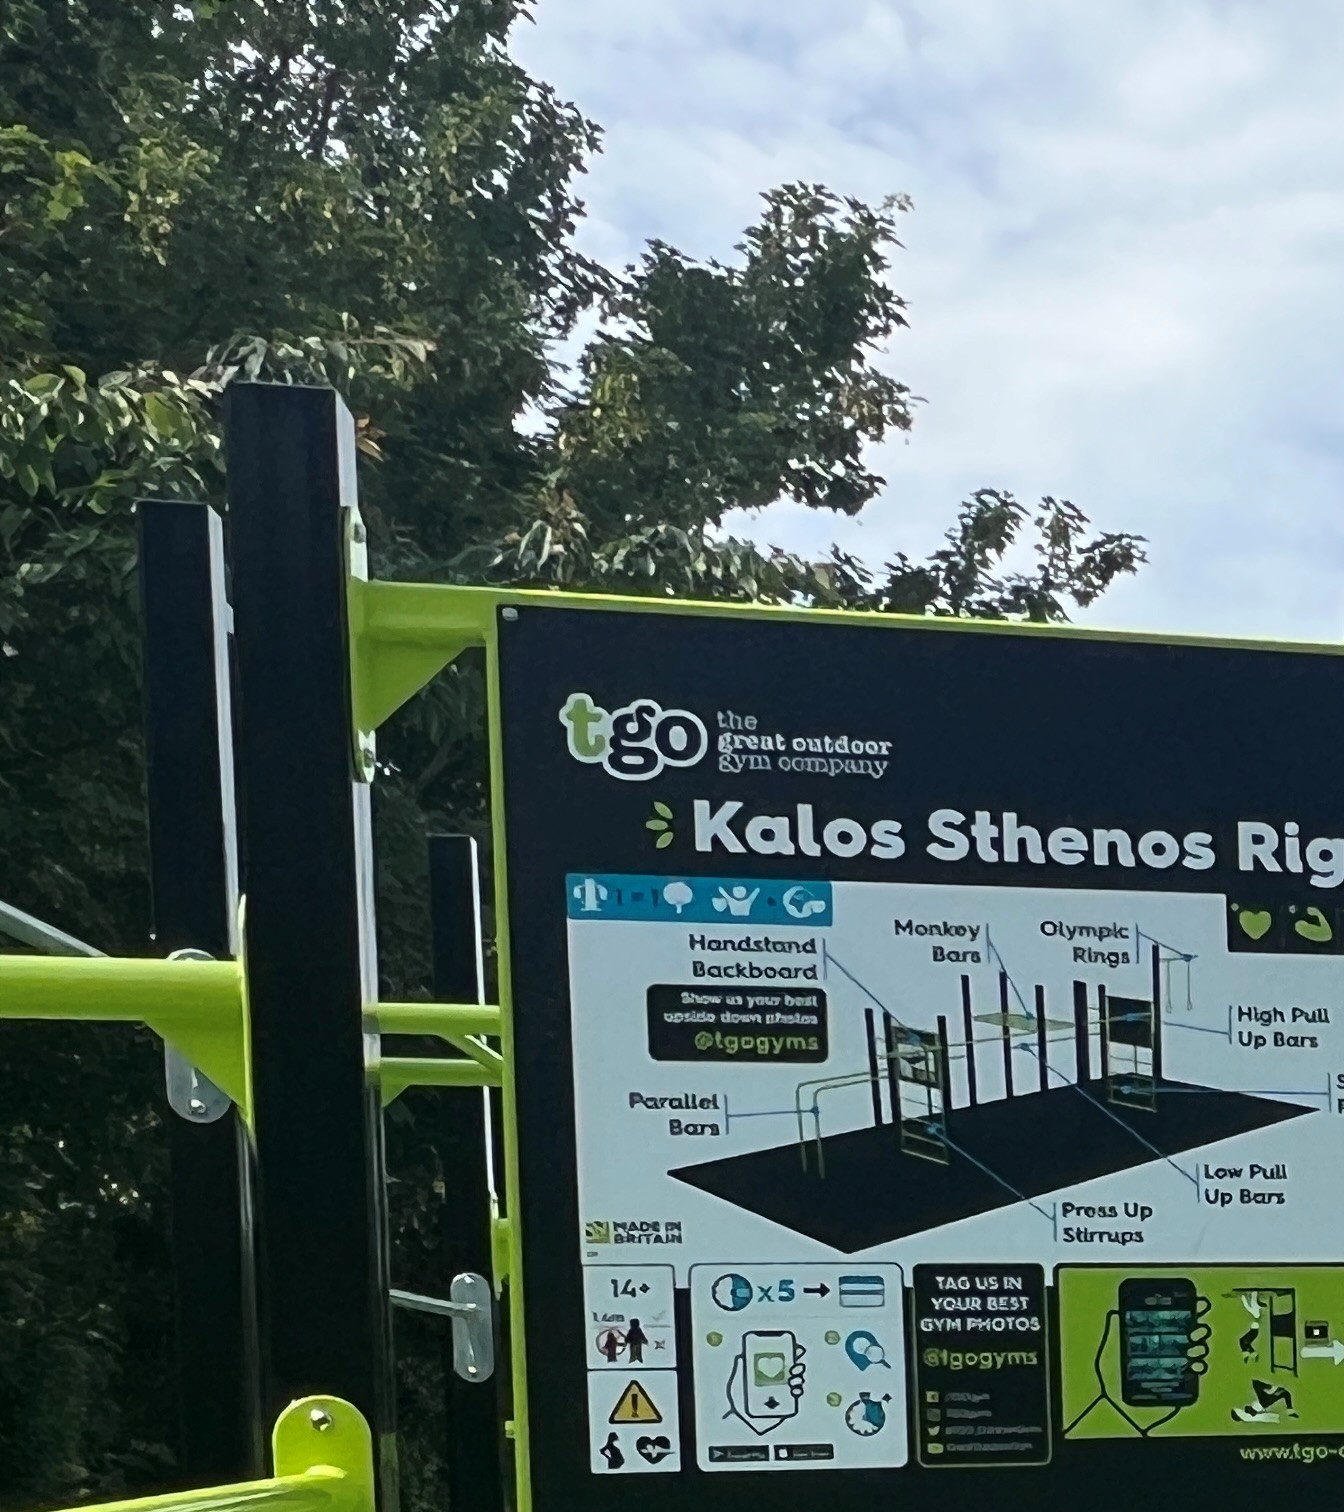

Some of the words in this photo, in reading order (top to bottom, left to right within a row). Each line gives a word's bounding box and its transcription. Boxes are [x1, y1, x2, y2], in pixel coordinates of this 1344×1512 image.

[717, 711, 758, 730] the
[559, 693, 708, 781] tgo
[717, 733, 785, 754] great
[792, 736, 893, 755] outdoor
[718, 753, 772, 773] gym
[779, 754, 889, 779] company
[693, 799, 905, 859] Kalos
[926, 808, 1216, 870] Sthenos
[894, 919, 981, 941] Monkey
[1040, 920, 1130, 941] Olympic
[689, 934, 818, 954] Handstand
[932, 946, 982, 963] Bars
[1073, 947, 1131, 968] Rings
[692, 961, 818, 980] Backboard
[1238, 1005, 1285, 1026] High
[1291, 1007, 1331, 1024] Pull
[694, 1031, 819, 1054] @tgogyms
[1238, 1031, 1267, 1050] Up
[1273, 1032, 1319, 1048] Bars
[629, 1091, 720, 1110] Parallel
[669, 1119, 720, 1136] Bars
[1204, 1164, 1243, 1180] Low
[1249, 1163, 1288, 1180] Pull
[1204, 1188, 1233, 1207] Up
[1240, 1189, 1285, 1205] Bars
[1061, 1202, 1118, 1218] Press
[1124, 1203, 1153, 1221] Up
[612, 1221, 661, 1232] MADE
[664, 1221, 682, 1232] IN
[614, 1233, 683, 1244] BRITAIN
[1063, 1227, 1145, 1246] Stirrups
[611, 1279, 651, 1298] 14+
[935, 1276, 970, 1290] TAG
[975, 1276, 999, 1290] US
[1004, 1276, 1023, 1290] IN
[931, 1297, 982, 1311] YOUR
[986, 1297, 1029, 1311] BEST
[920, 1318, 962, 1332] GYM
[966, 1317, 1041, 1332] PHOTOS
[923, 1348, 1038, 1370] @tgogyms
